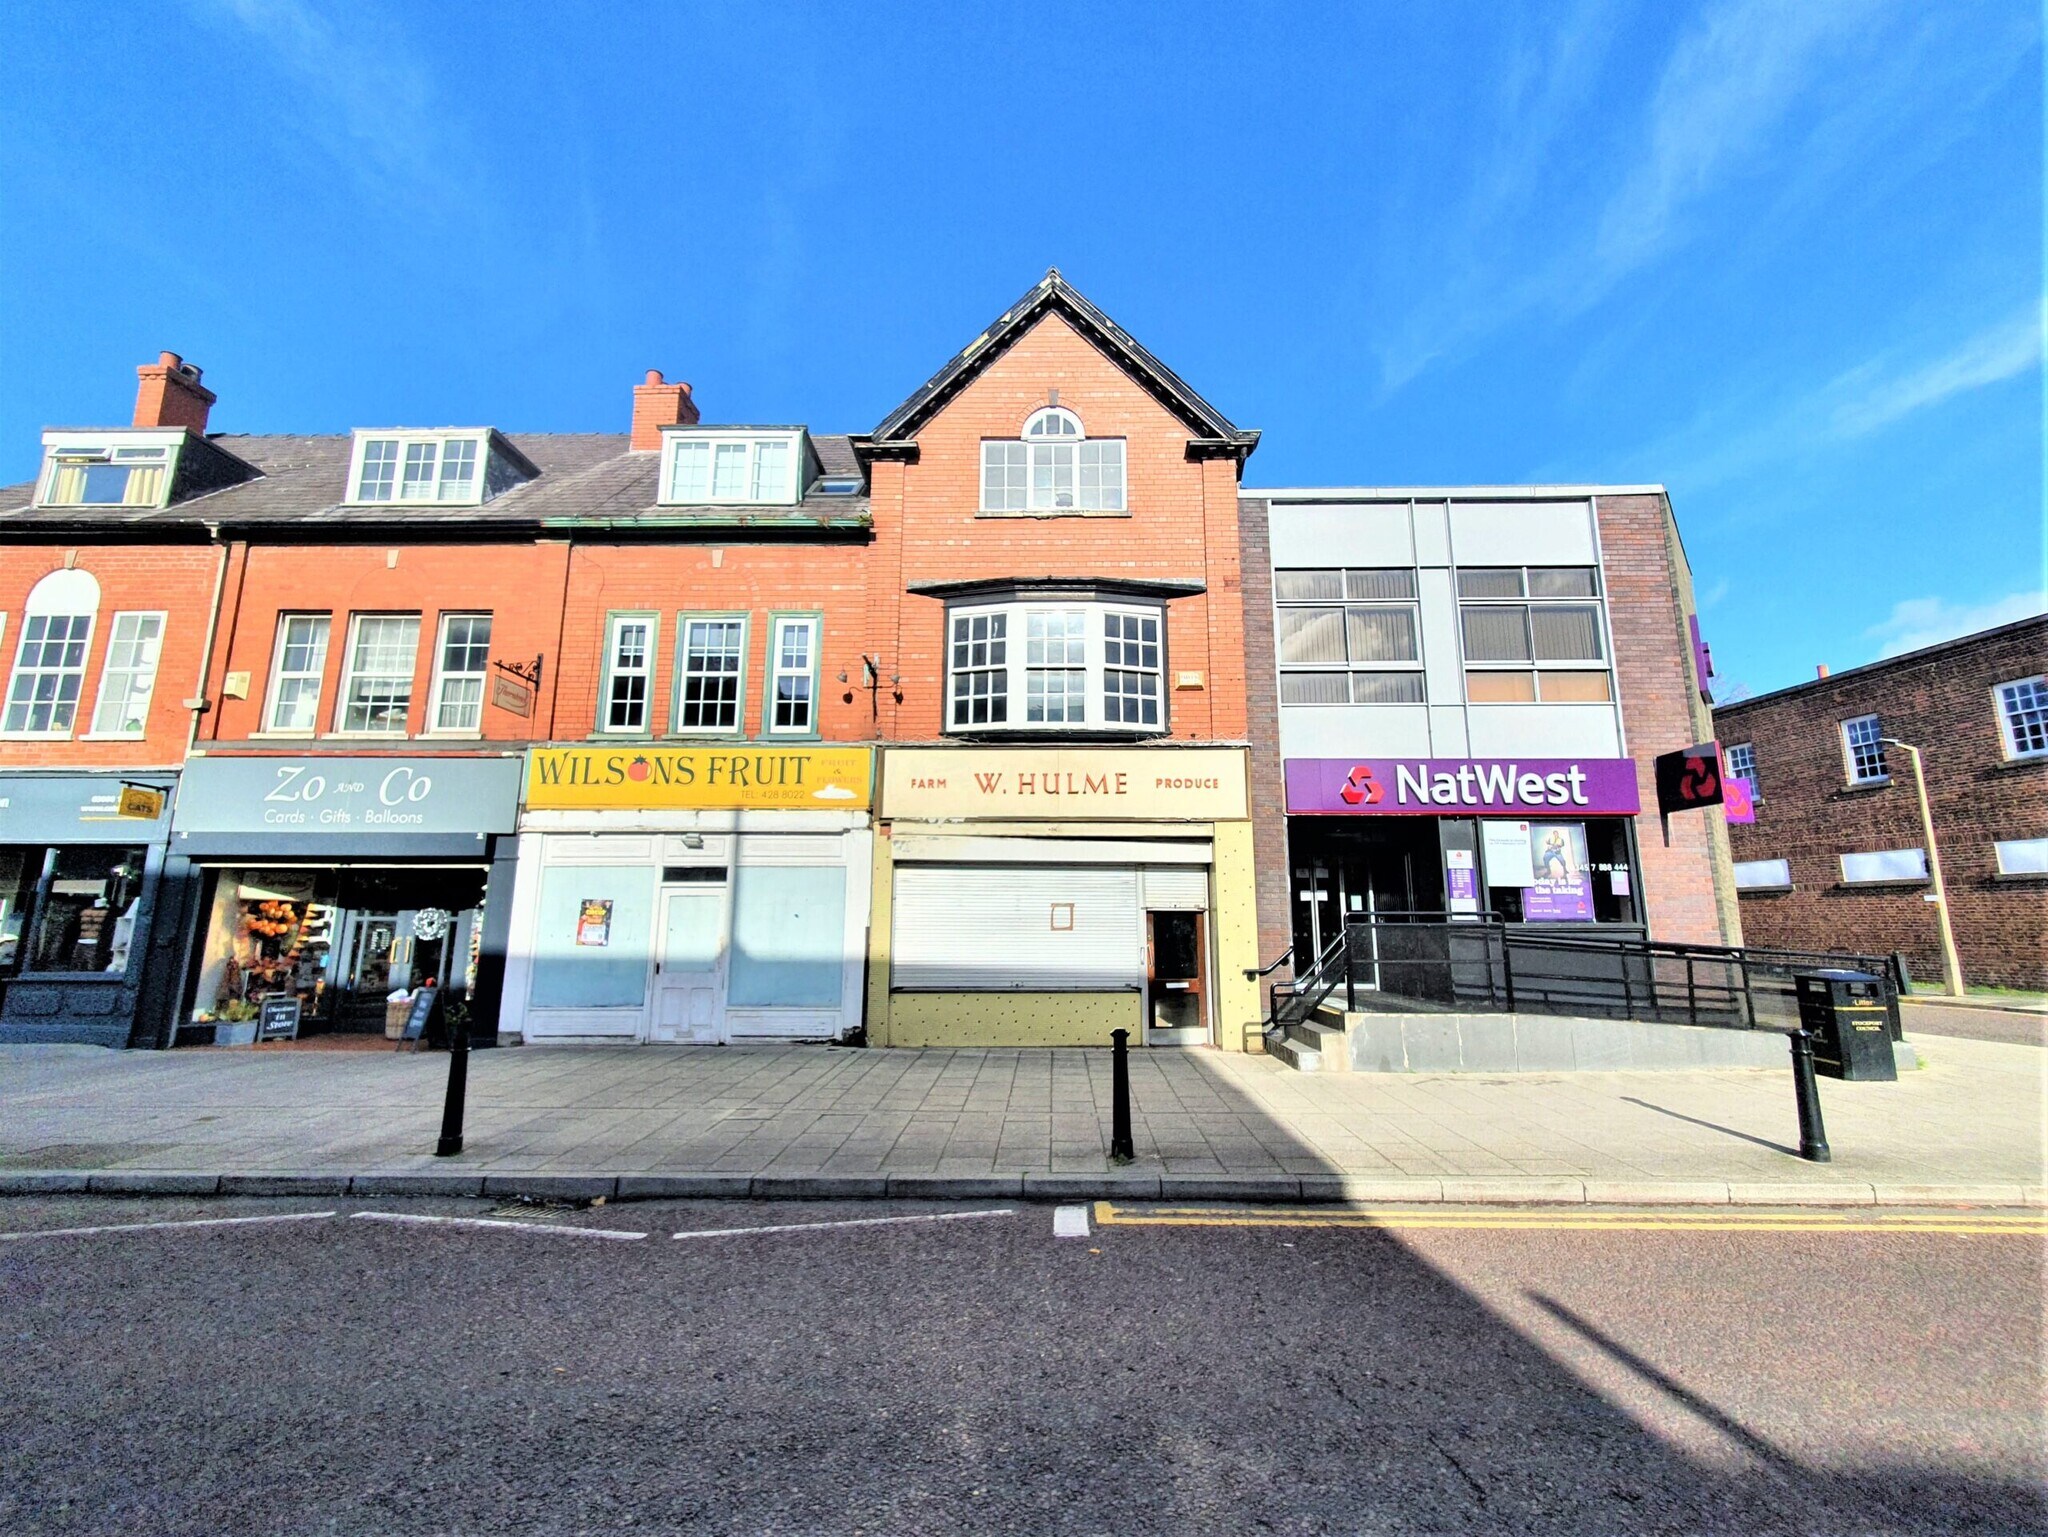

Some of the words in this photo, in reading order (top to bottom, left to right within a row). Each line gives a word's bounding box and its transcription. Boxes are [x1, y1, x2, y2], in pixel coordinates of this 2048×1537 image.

[820, 758, 857, 767] FRUIT
[707, 755, 812, 788] FRUIT
[263, 766, 327, 802] Zo
[332, 782, 365, 794] AND
[379, 766, 432, 806] Co
[816, 776, 863, 785] FLOWERS
[910, 778, 947, 789] FARM
[974, 772, 1007, 795] W.
[1018, 772, 1127, 795] HULME
[1155, 778, 1219, 789] PRODUCE
[1395, 764, 1589, 805] NatWest
[740, 790, 756, 799] TEL:
[761, 790, 779, 799] 428
[782, 790, 806, 799] 8022
[264, 809, 306, 824] Cards
[319, 808, 351, 824] Gifts
[364, 809, 423, 824] Balloons
[1590, 863, 1597, 872] 7
[1613, 863, 1629, 872] 444
[1534, 877, 1556, 888] oday
[1560, 878, 1567, 886] is
[1535, 885, 1551, 895] the
[1552, 885, 1585, 896] taking
